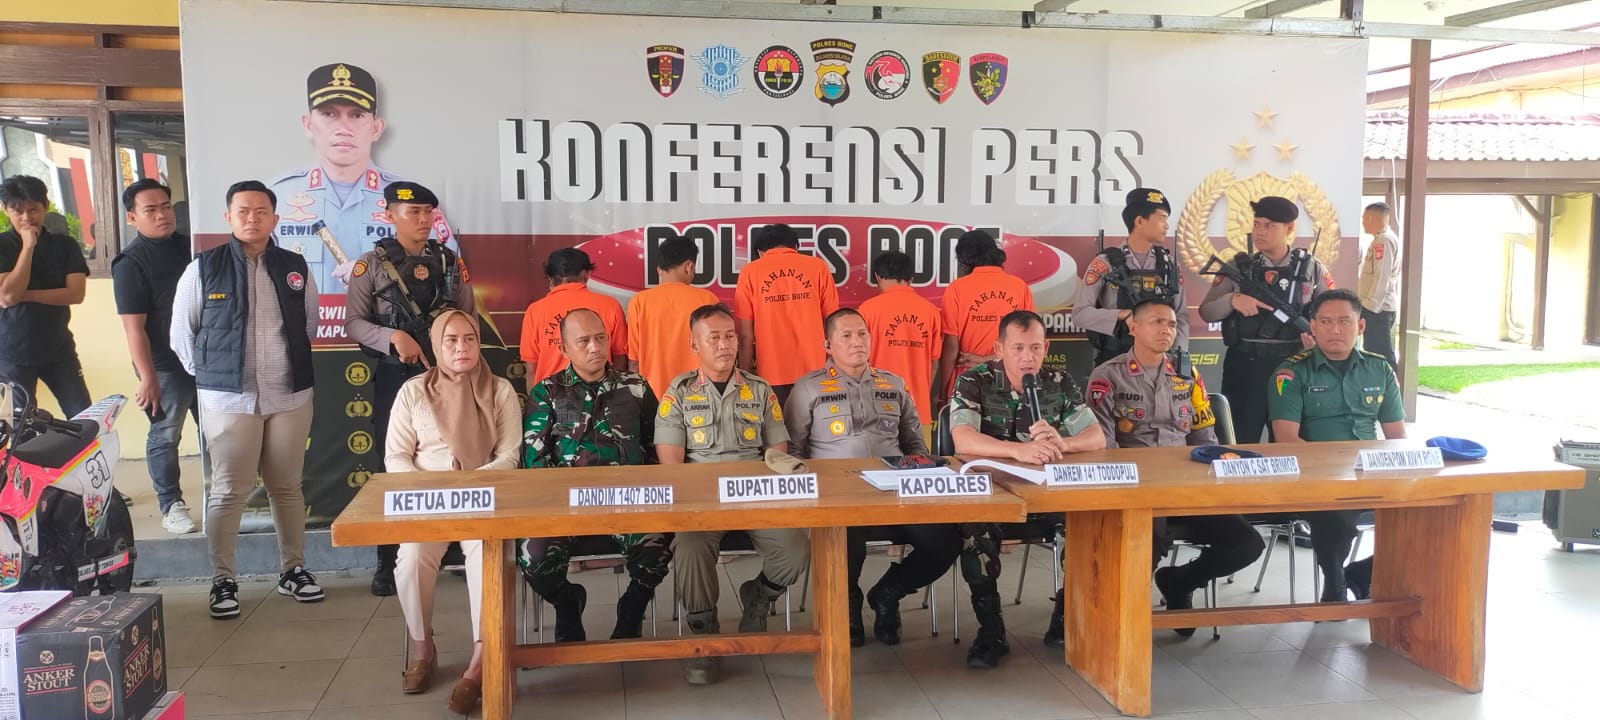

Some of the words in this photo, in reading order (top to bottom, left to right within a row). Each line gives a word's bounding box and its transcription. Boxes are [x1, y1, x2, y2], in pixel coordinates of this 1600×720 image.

[499, 118, 946, 205] KONFERENSI
[970, 128, 1144, 206] PERS
[761, 268, 812, 294] TAHANAN
[764, 294, 790, 303] POLRES
[969, 290, 1019, 312] TAHANAN
[885, 313, 928, 339] TAHANAN
[821, 392, 847, 402] ERWIN
[875, 391, 897, 399] POLRI
[1119, 392, 1144, 402] RUDI
[1053, 465, 1082, 482] DANREM
[1084, 466, 1095, 481] 141
[1096, 464, 1136, 481] TODDOPULI
[1221, 459, 1251, 476] DANYON
[1257, 458, 1271, 474] SAT
[727, 478, 774, 497] BUPATI
[778, 477, 815, 495] BONE
[901, 476, 987, 495] KAPOLRES
[393, 492, 446, 511] KETUA
[450, 490, 492, 509] DPRD
[578, 488, 616, 506] DANDIM
[618, 488, 641, 505] 1407
[643, 487, 670, 504] BONE
[123, 643, 151, 683] ANKER
[23, 668, 75, 684] ANKER
[27, 677, 71, 692] STOUT
